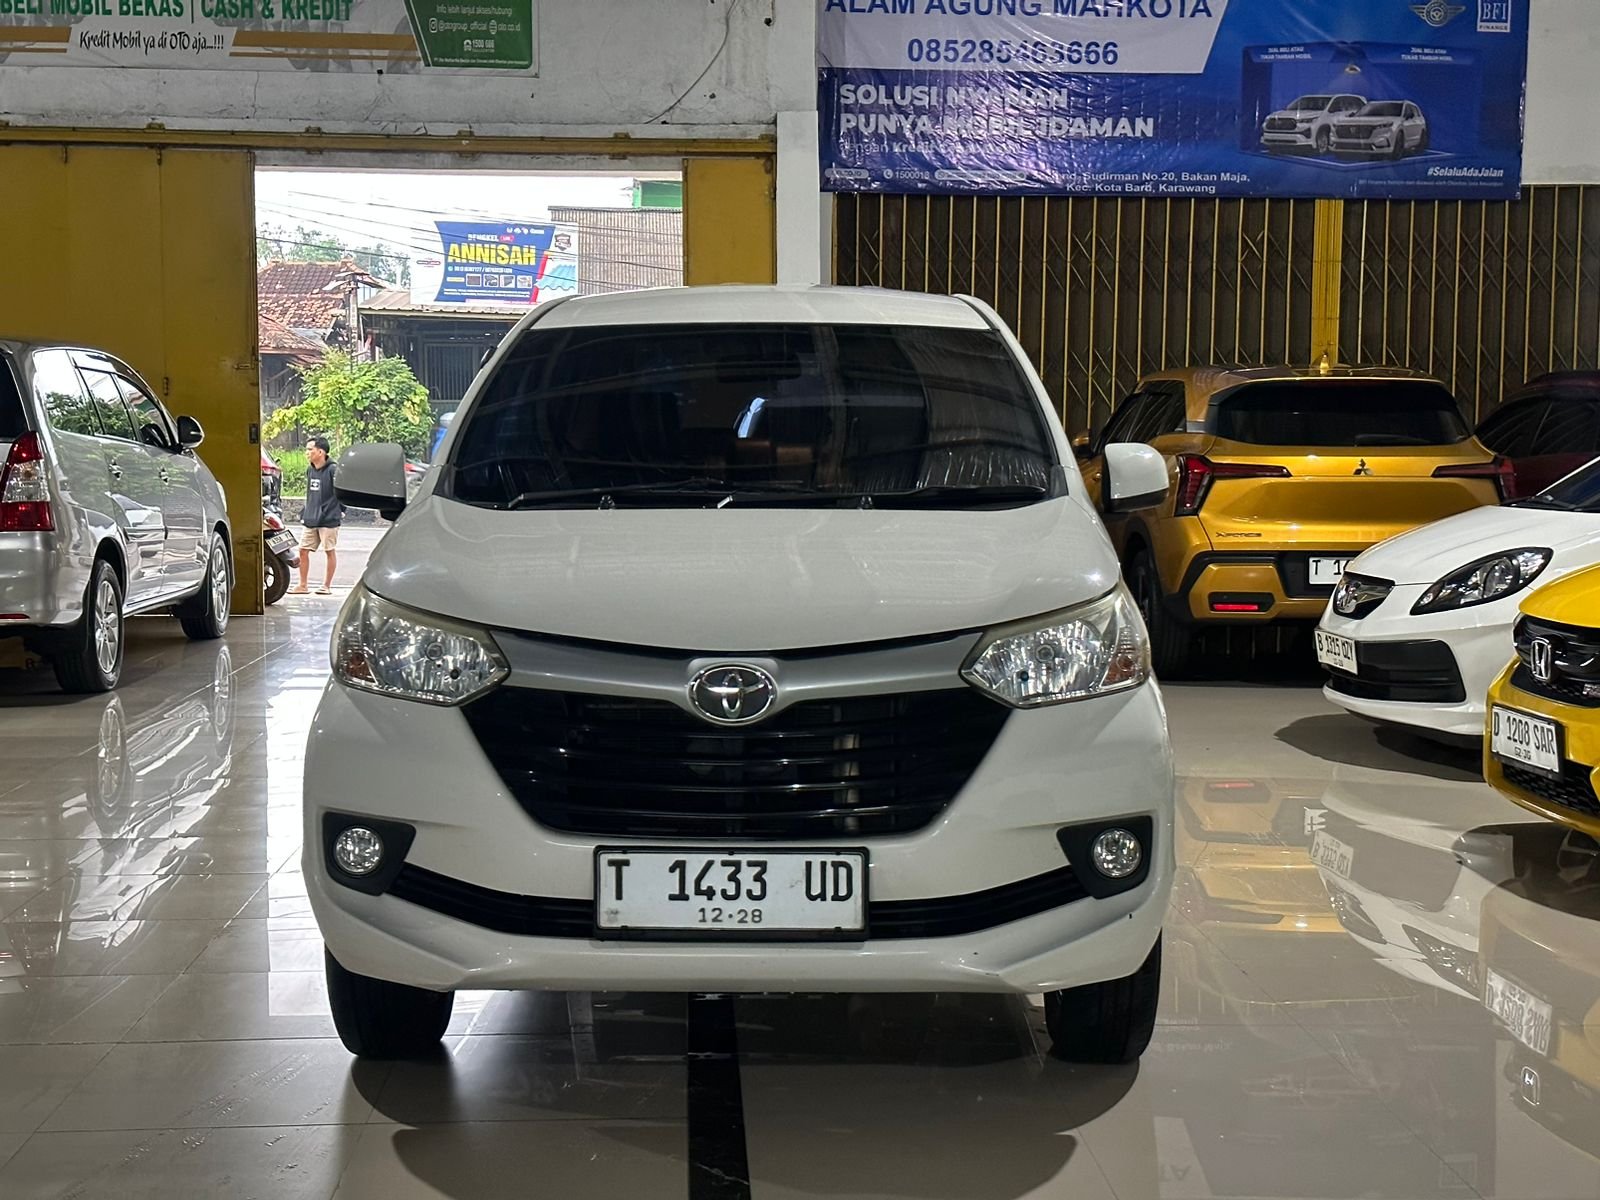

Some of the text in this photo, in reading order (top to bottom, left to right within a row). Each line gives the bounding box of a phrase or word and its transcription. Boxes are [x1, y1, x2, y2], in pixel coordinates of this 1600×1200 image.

[50, 0, 112, 16] MOBIL
[119, 0, 184, 17] BEKAS
[200, 0, 254, 18] CASH
[261, 0, 275, 18] &
[282, 0, 352, 21] KREDIT
[825, 0, 915, 14] ALAM
[924, 0, 1042, 17] AGUNG
[1483, 2, 1508, 20] BFI
[79, 31, 110, 50] Kredit
[112, 31, 141, 49] Mobil
[142, 35, 156, 55] ya
[158, 31, 168, 49] di
[170, 32, 190, 50] OTO
[840, 84, 938, 106] SOLUSI
[840, 113, 934, 135] PUNYA
[1041, 116, 1155, 138] IDAMAN
[1142, 171, 1178, 183] No.20,
[1181, 172, 1218, 181] Bakan
[1220, 172, 1250, 183] Maja,
[1427, 166, 1504, 177] #SelaluAdaJalan
[1095, 183, 1122, 192] Kota
[1159, 183, 1216, 194] Karawang
[448, 242, 536, 265] ANNISAH
[1312, 560, 1321, 575] T
[1317, 633, 1324, 651] B
[1493, 711, 1556, 755] D 1208 SAR
[607, 858, 854, 902] T 1433 UD
